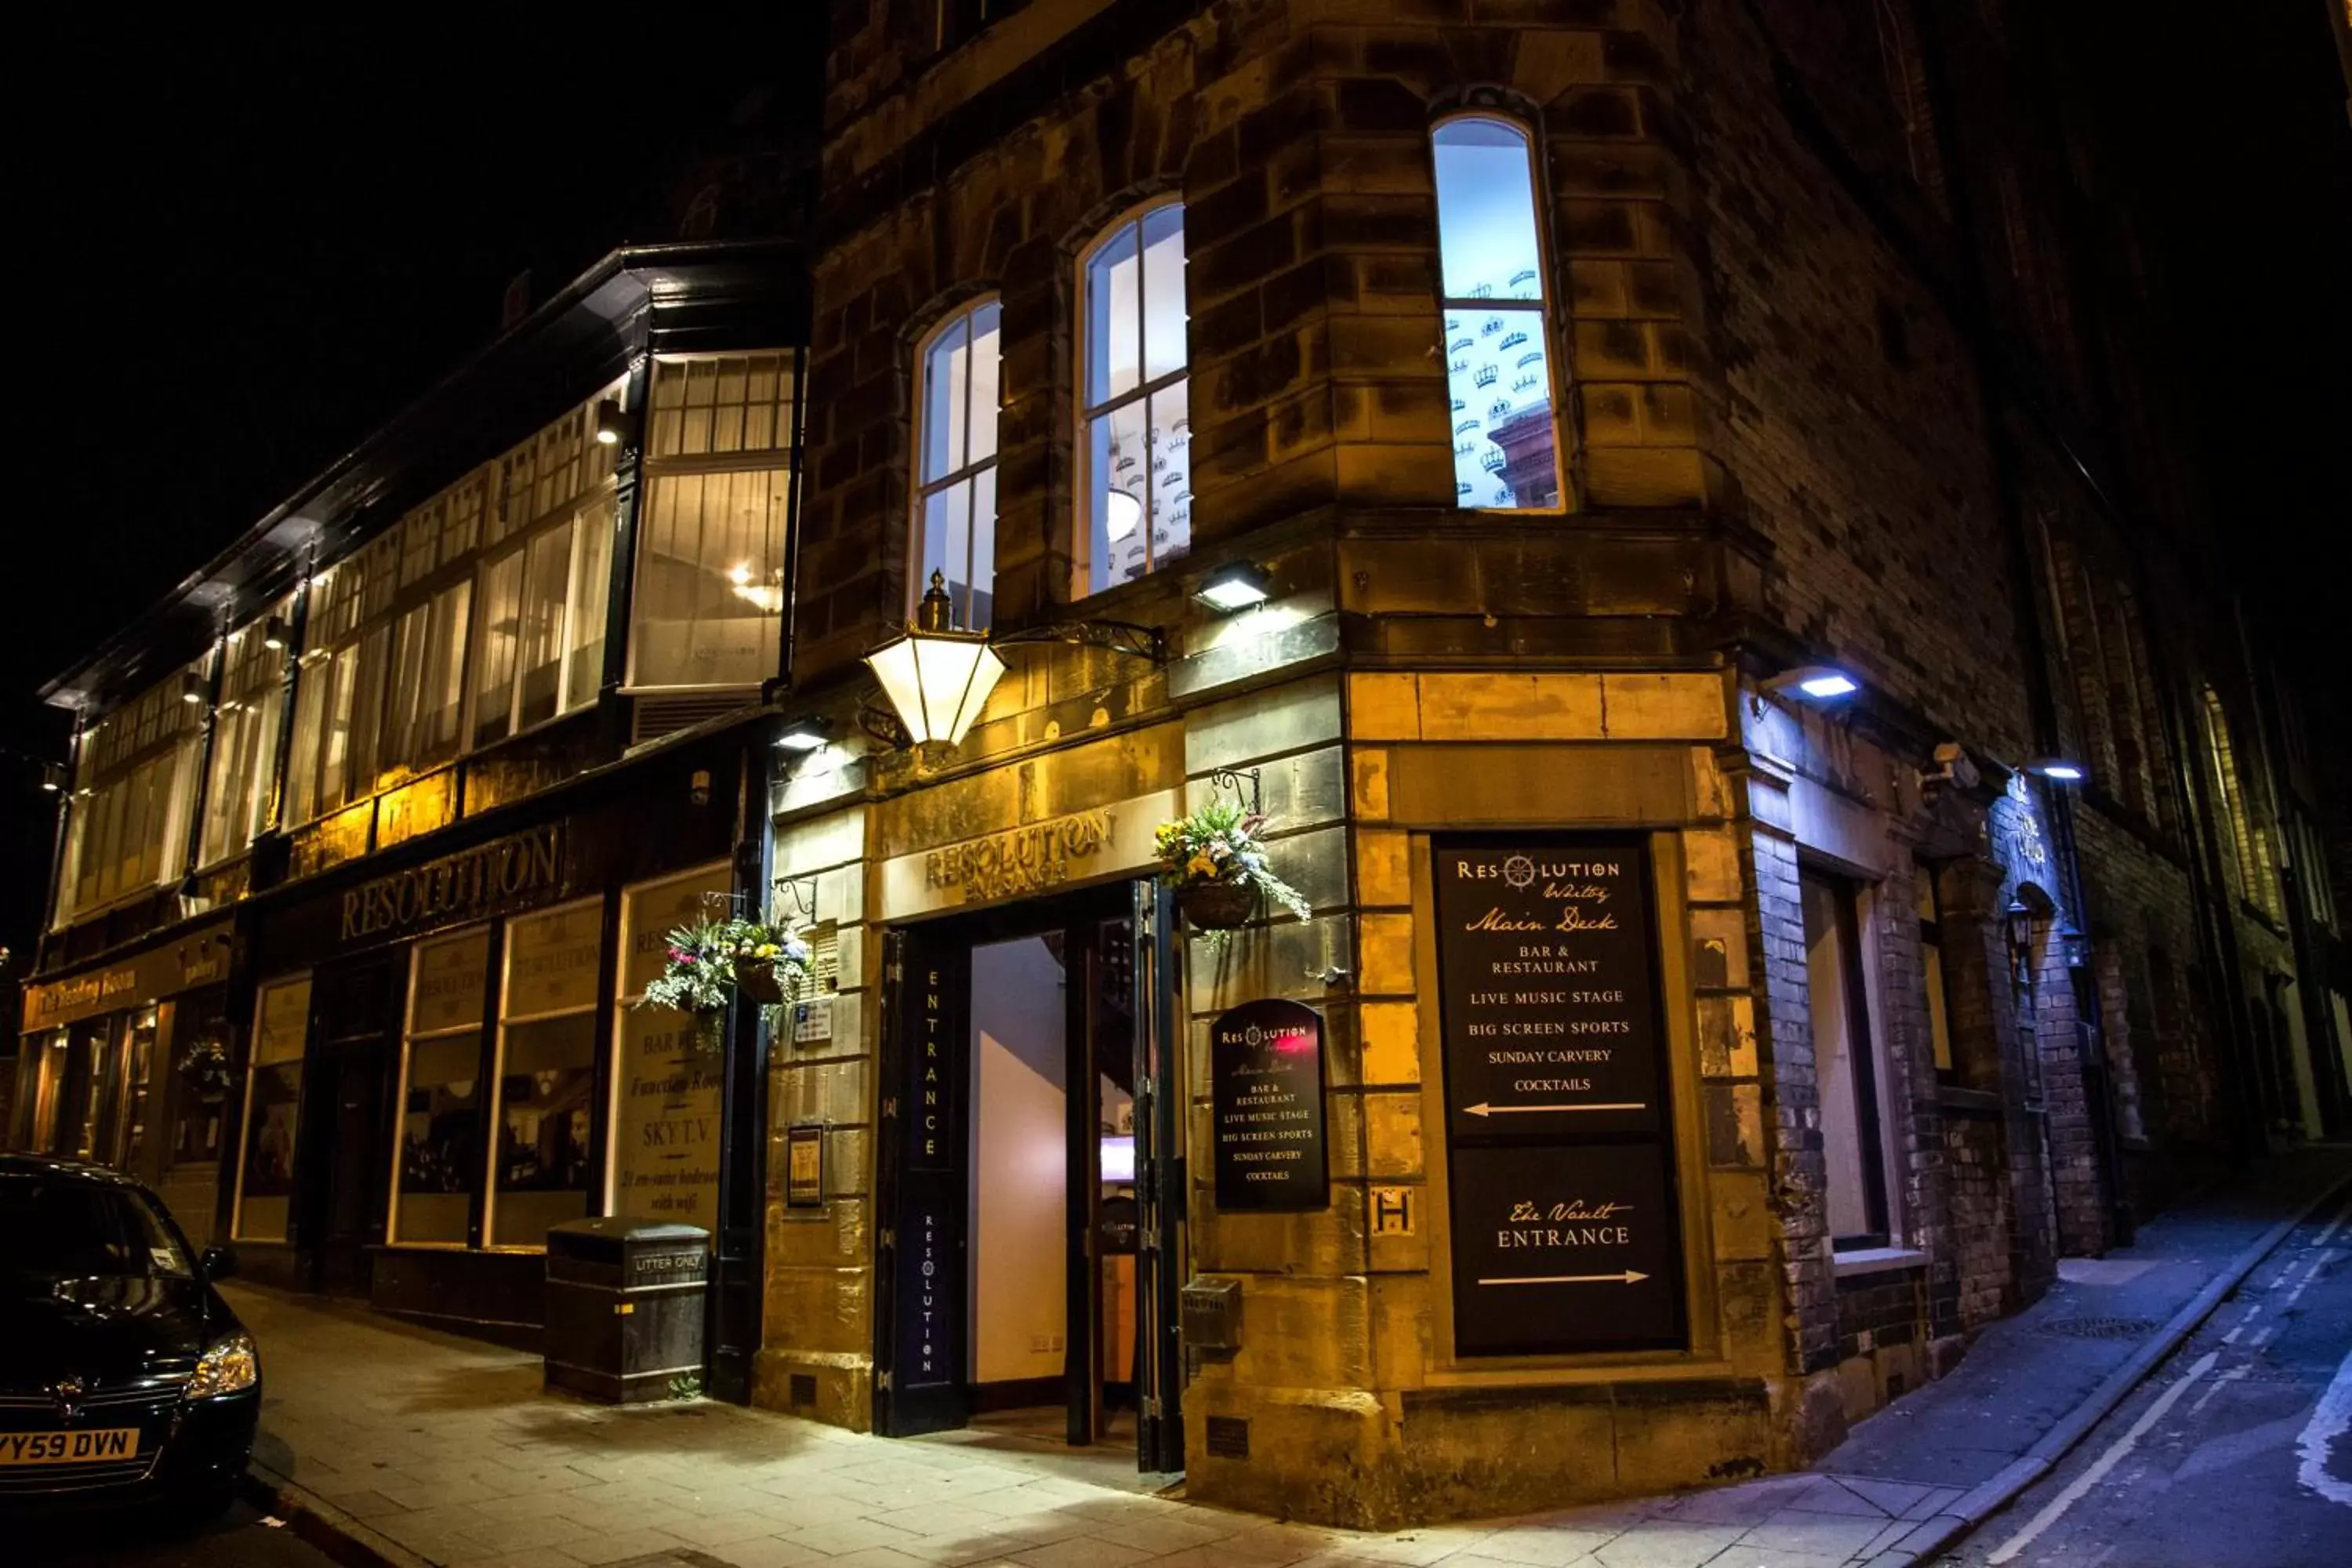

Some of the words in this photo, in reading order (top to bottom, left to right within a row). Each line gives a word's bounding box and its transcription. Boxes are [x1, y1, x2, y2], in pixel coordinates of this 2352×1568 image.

[925, 810, 1117, 890] RESOLUTION
[339, 824, 558, 941] RESOLUTION
[1543, 883, 1610, 903] Whitby
[1465, 907, 1546, 931] Main
[1555, 906, 1619, 931] Deck
[1519, 946, 1551, 958] BAR
[1558, 945, 1569, 956] &
[1492, 960, 1599, 974] RESTAURANT
[1470, 993, 1508, 1005] LIVE
[1515, 992, 1566, 1004] MUSIC
[1572, 990, 1624, 1003] STAGE
[1468, 1024, 1497, 1036] BIG
[1503, 1022, 1565, 1035] SCREEN
[1571, 1021, 1630, 1034] SPORTS
[644, 1033, 673, 1055] BAR
[925, 969, 938, 1156] ENTRANCE
[1489, 1051, 1544, 1065] SUNDAY
[1547, 1049, 1612, 1063] CARVERY
[1250, 1085, 1269, 1094] BAR
[1514, 1078, 1591, 1092] COCKTAILS
[1236, 1094, 1295, 1106] RESTAURANT
[1224, 1114, 1244, 1123] LIVE
[1247, 1112, 1277, 1122] MUSIC
[1280, 1110, 1310, 1120] STAGE
[643, 1121, 674, 1147] SKY
[1222, 1133, 1238, 1142] BIG
[1241, 1131, 1276, 1142] SCREEN
[1278, 1129, 1312, 1139] SPORTS
[1232, 1152, 1263, 1161] SUNDAY
[1264, 1150, 1301, 1160] CARVERY
[1246, 1171, 1290, 1181] COCKTAILS
[1377, 1192, 1408, 1232] H
[1509, 1200, 1542, 1221] The
[1548, 1199, 1635, 1221] Vault
[1497, 1227, 1630, 1247] ENTRANCE
[636, 1258, 672, 1271] LITTER
[921, 1215, 935, 1372] RESOLUTION
[73, 1432, 129, 1457] DVN
